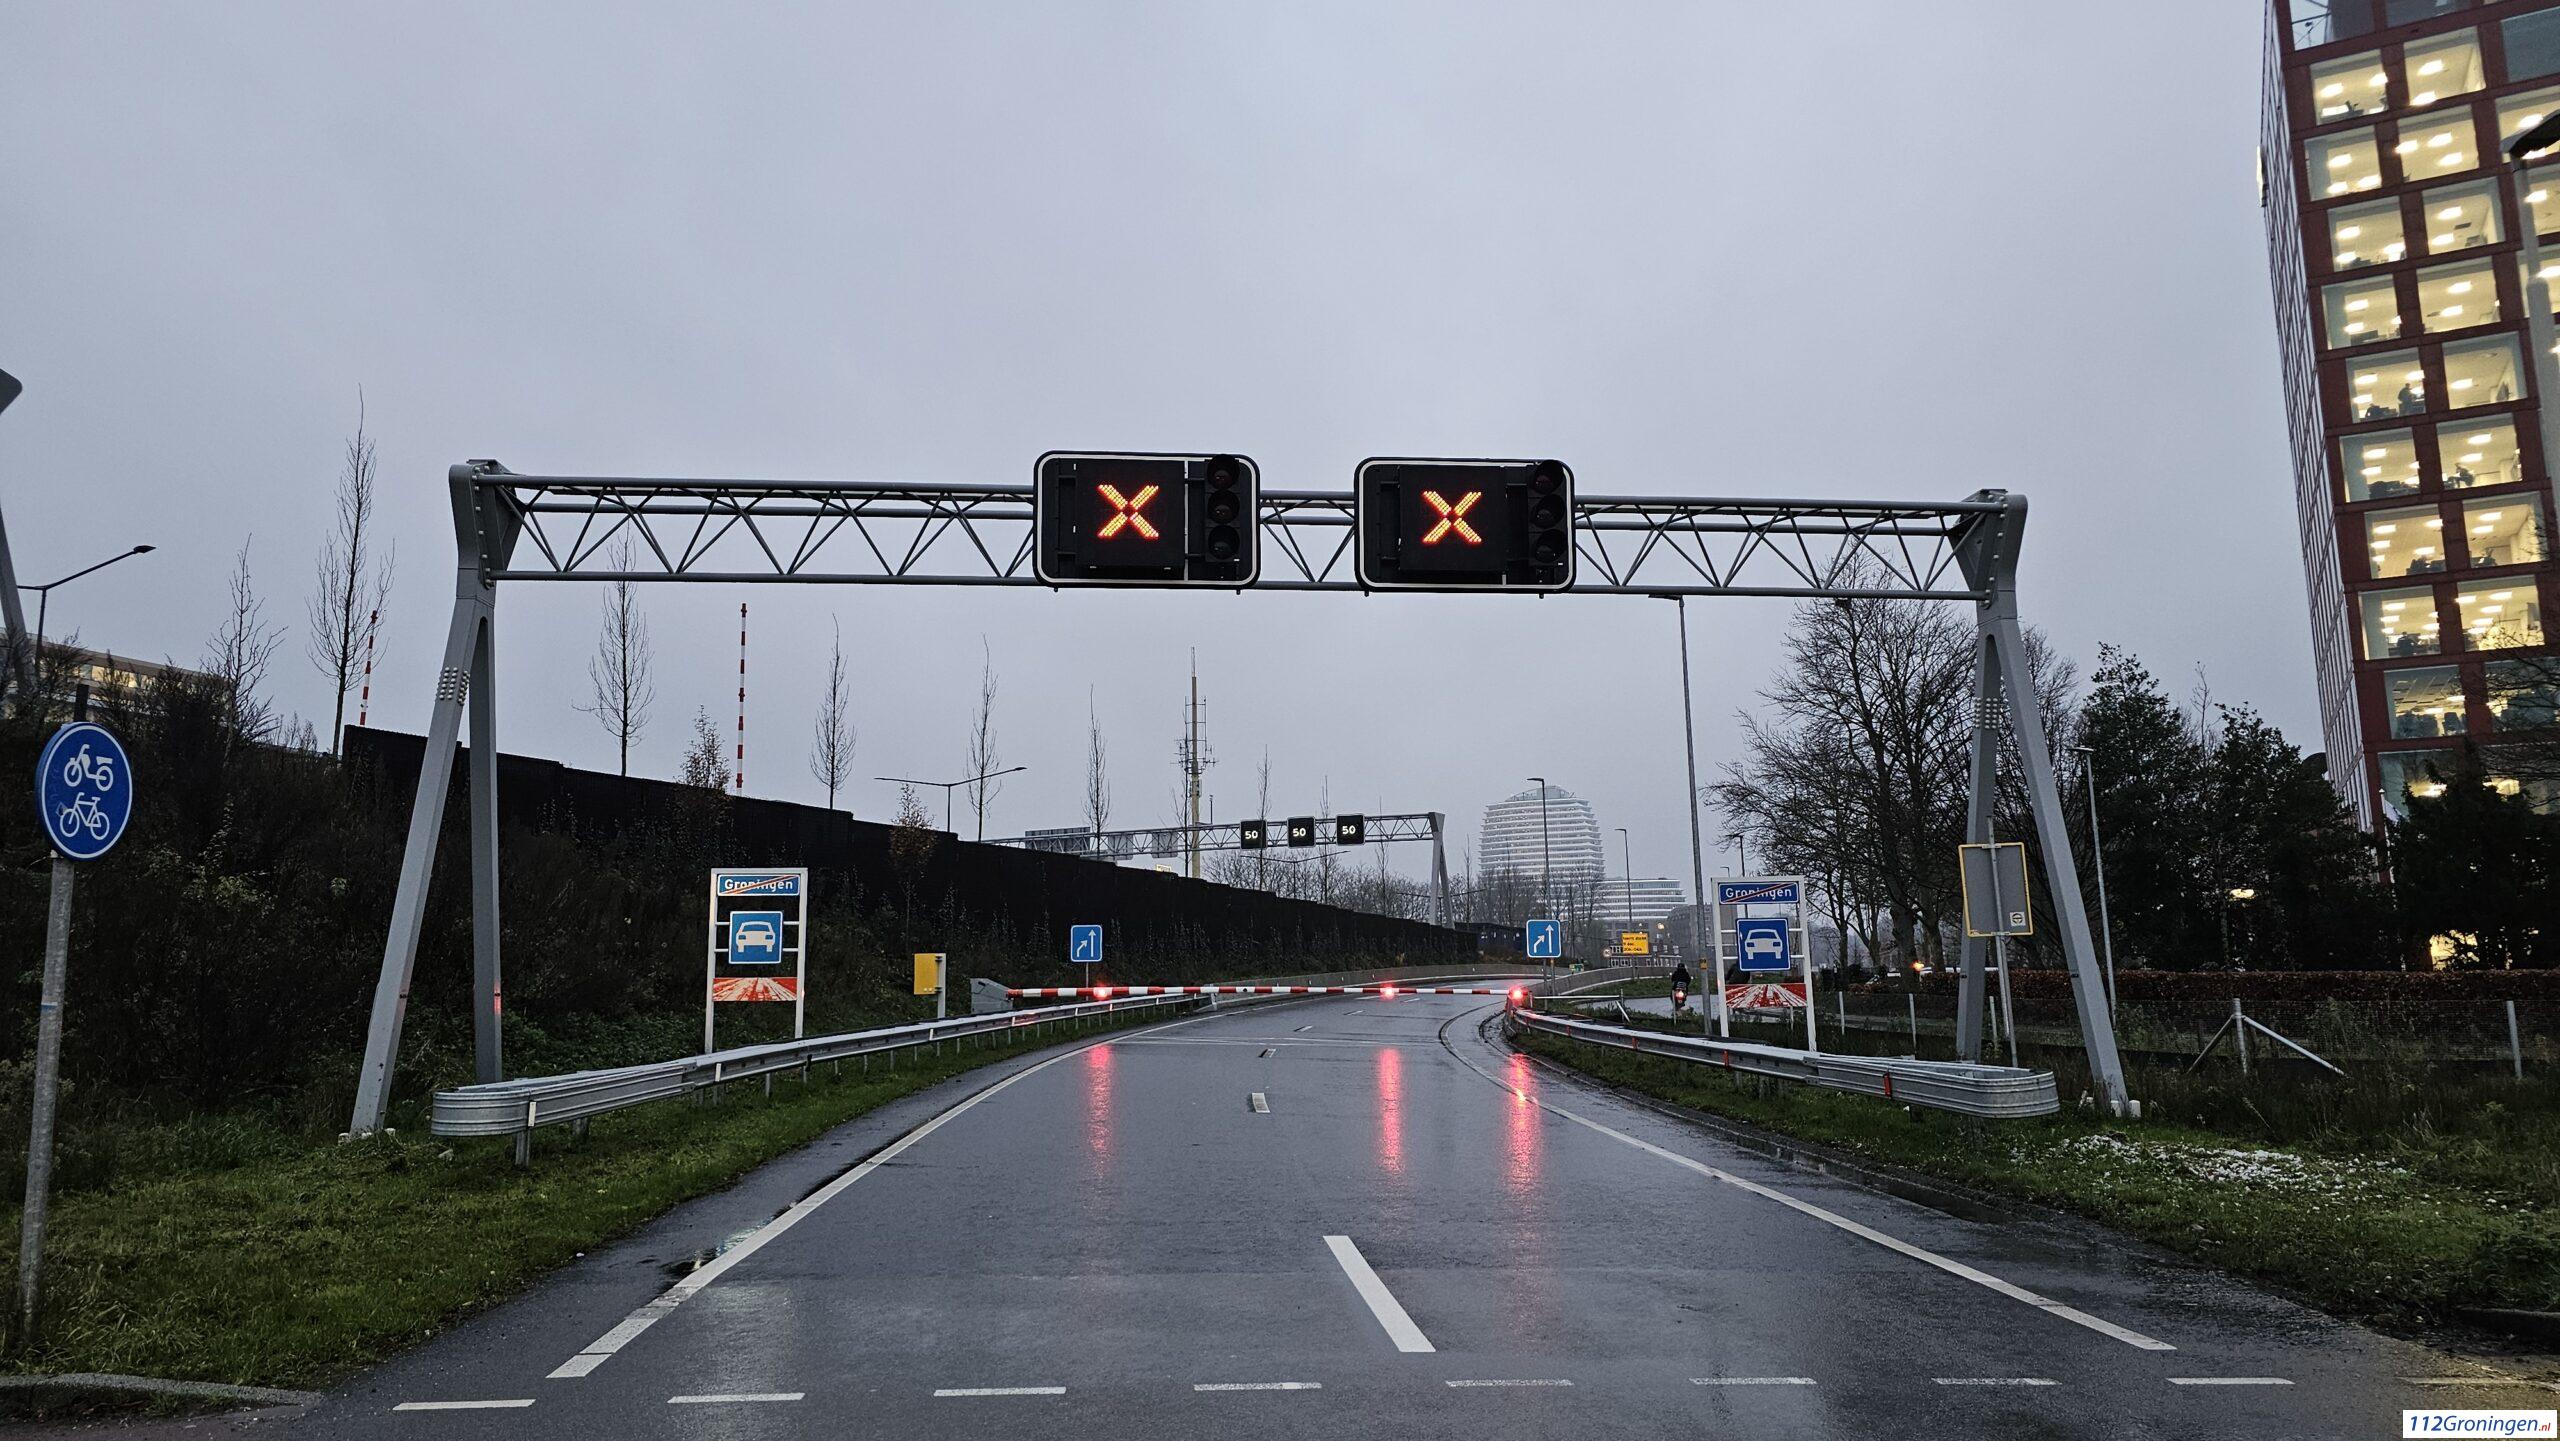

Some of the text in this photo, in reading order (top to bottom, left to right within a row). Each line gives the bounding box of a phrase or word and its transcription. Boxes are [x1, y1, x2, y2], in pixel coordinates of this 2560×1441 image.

[1244, 830, 1258, 840] 50
[1292, 827, 1307, 837] 50
[1342, 825, 1356, 835] 50
[1725, 887, 1792, 900] Groningen
